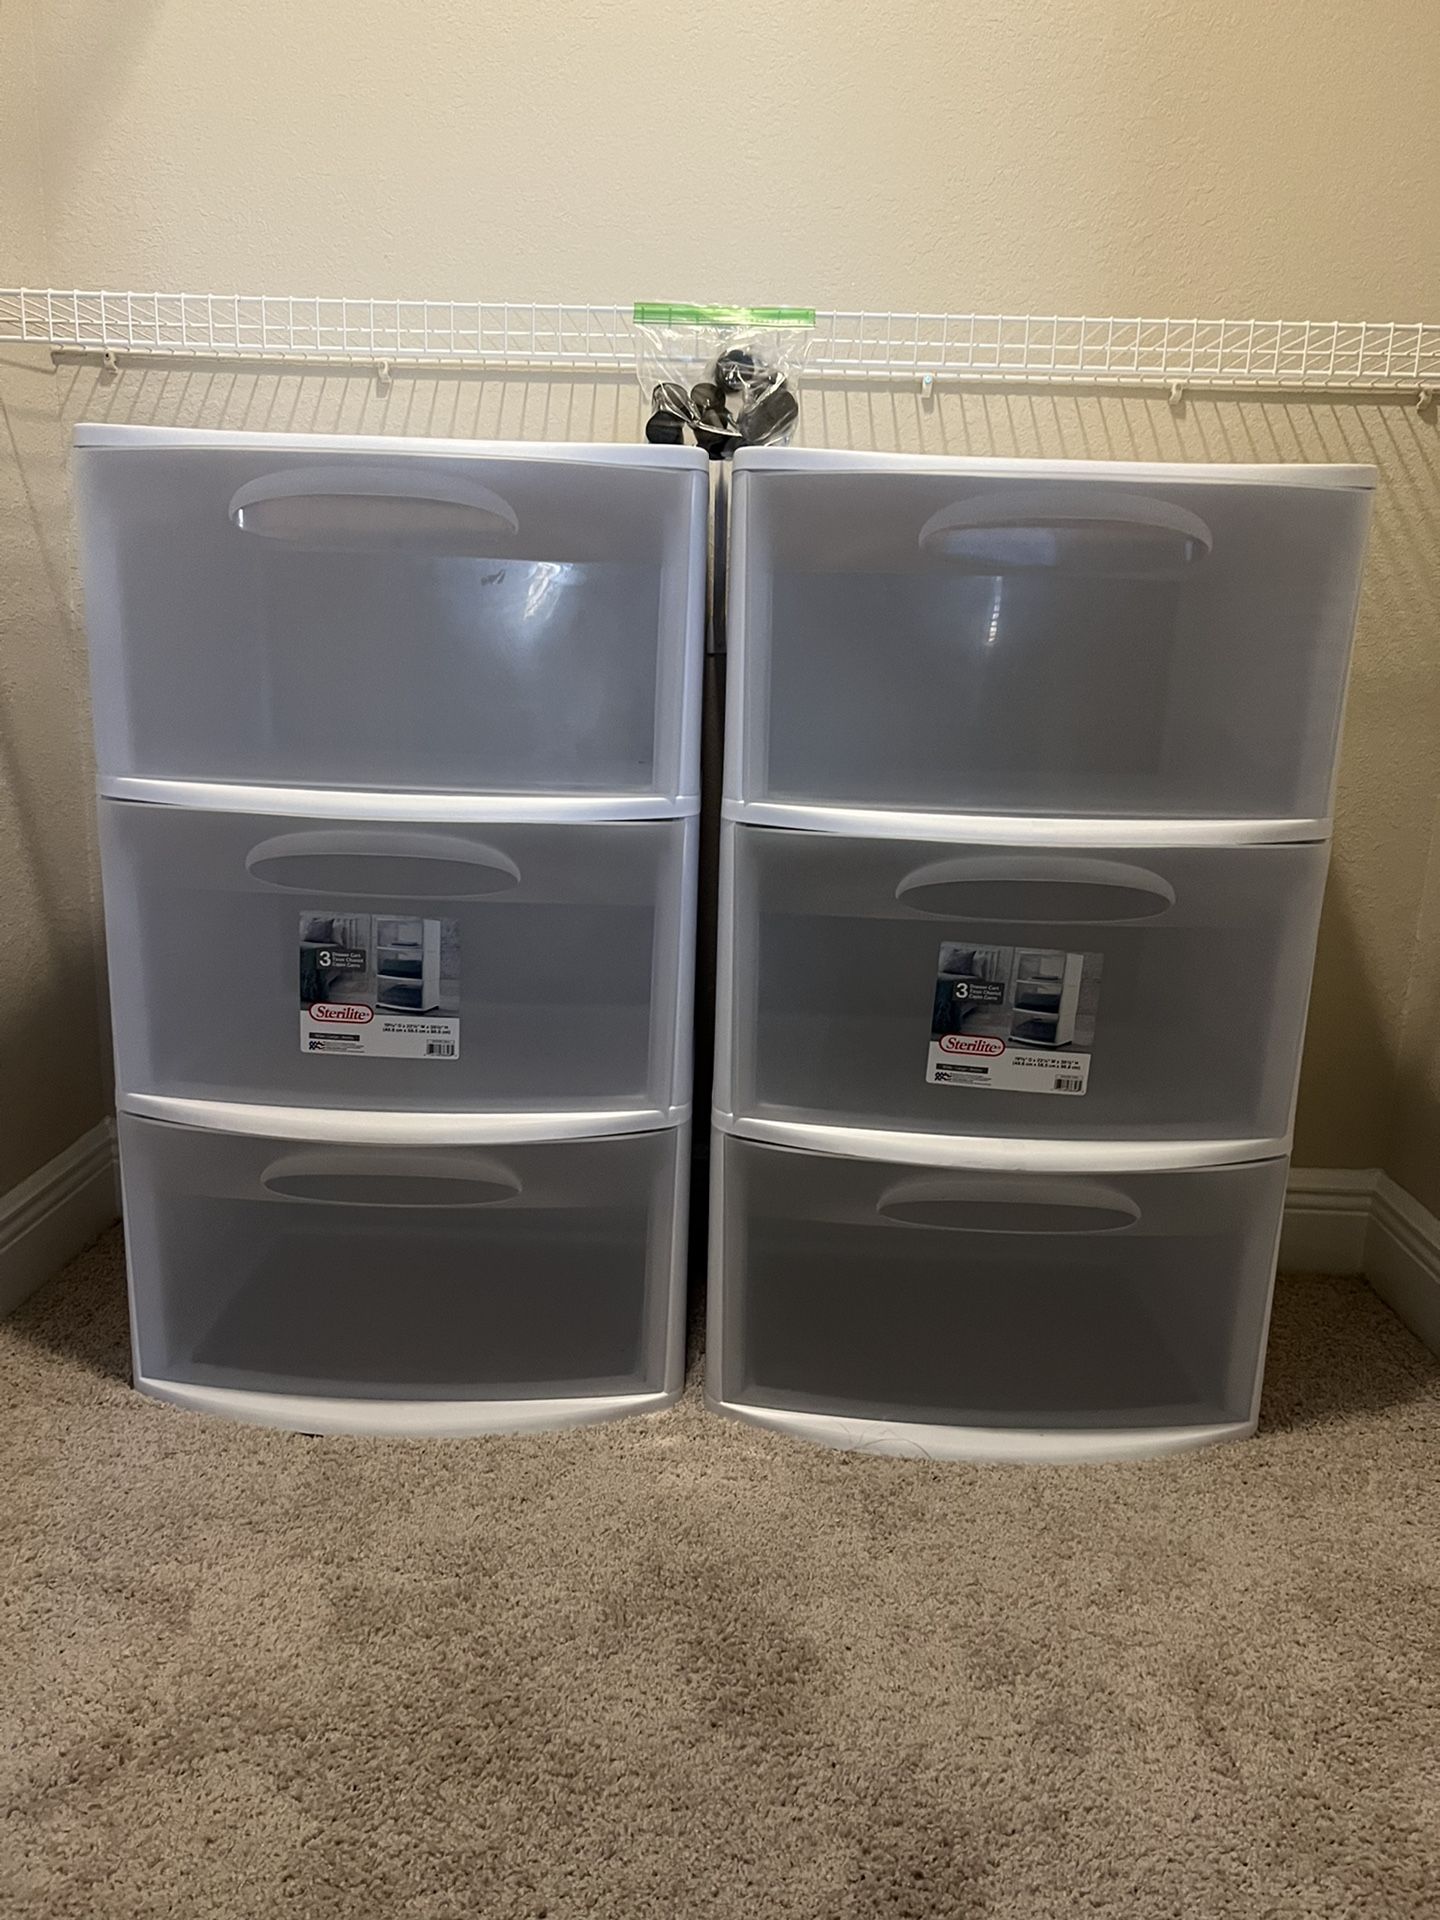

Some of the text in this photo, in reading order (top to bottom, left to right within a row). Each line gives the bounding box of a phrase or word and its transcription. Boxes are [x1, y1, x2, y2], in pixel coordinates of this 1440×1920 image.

[319, 951, 331, 967] 3
[956, 983, 968, 998] 3
[316, 1005, 366, 1020] Sterilite
[946, 1037, 997, 1053] Sterilite
